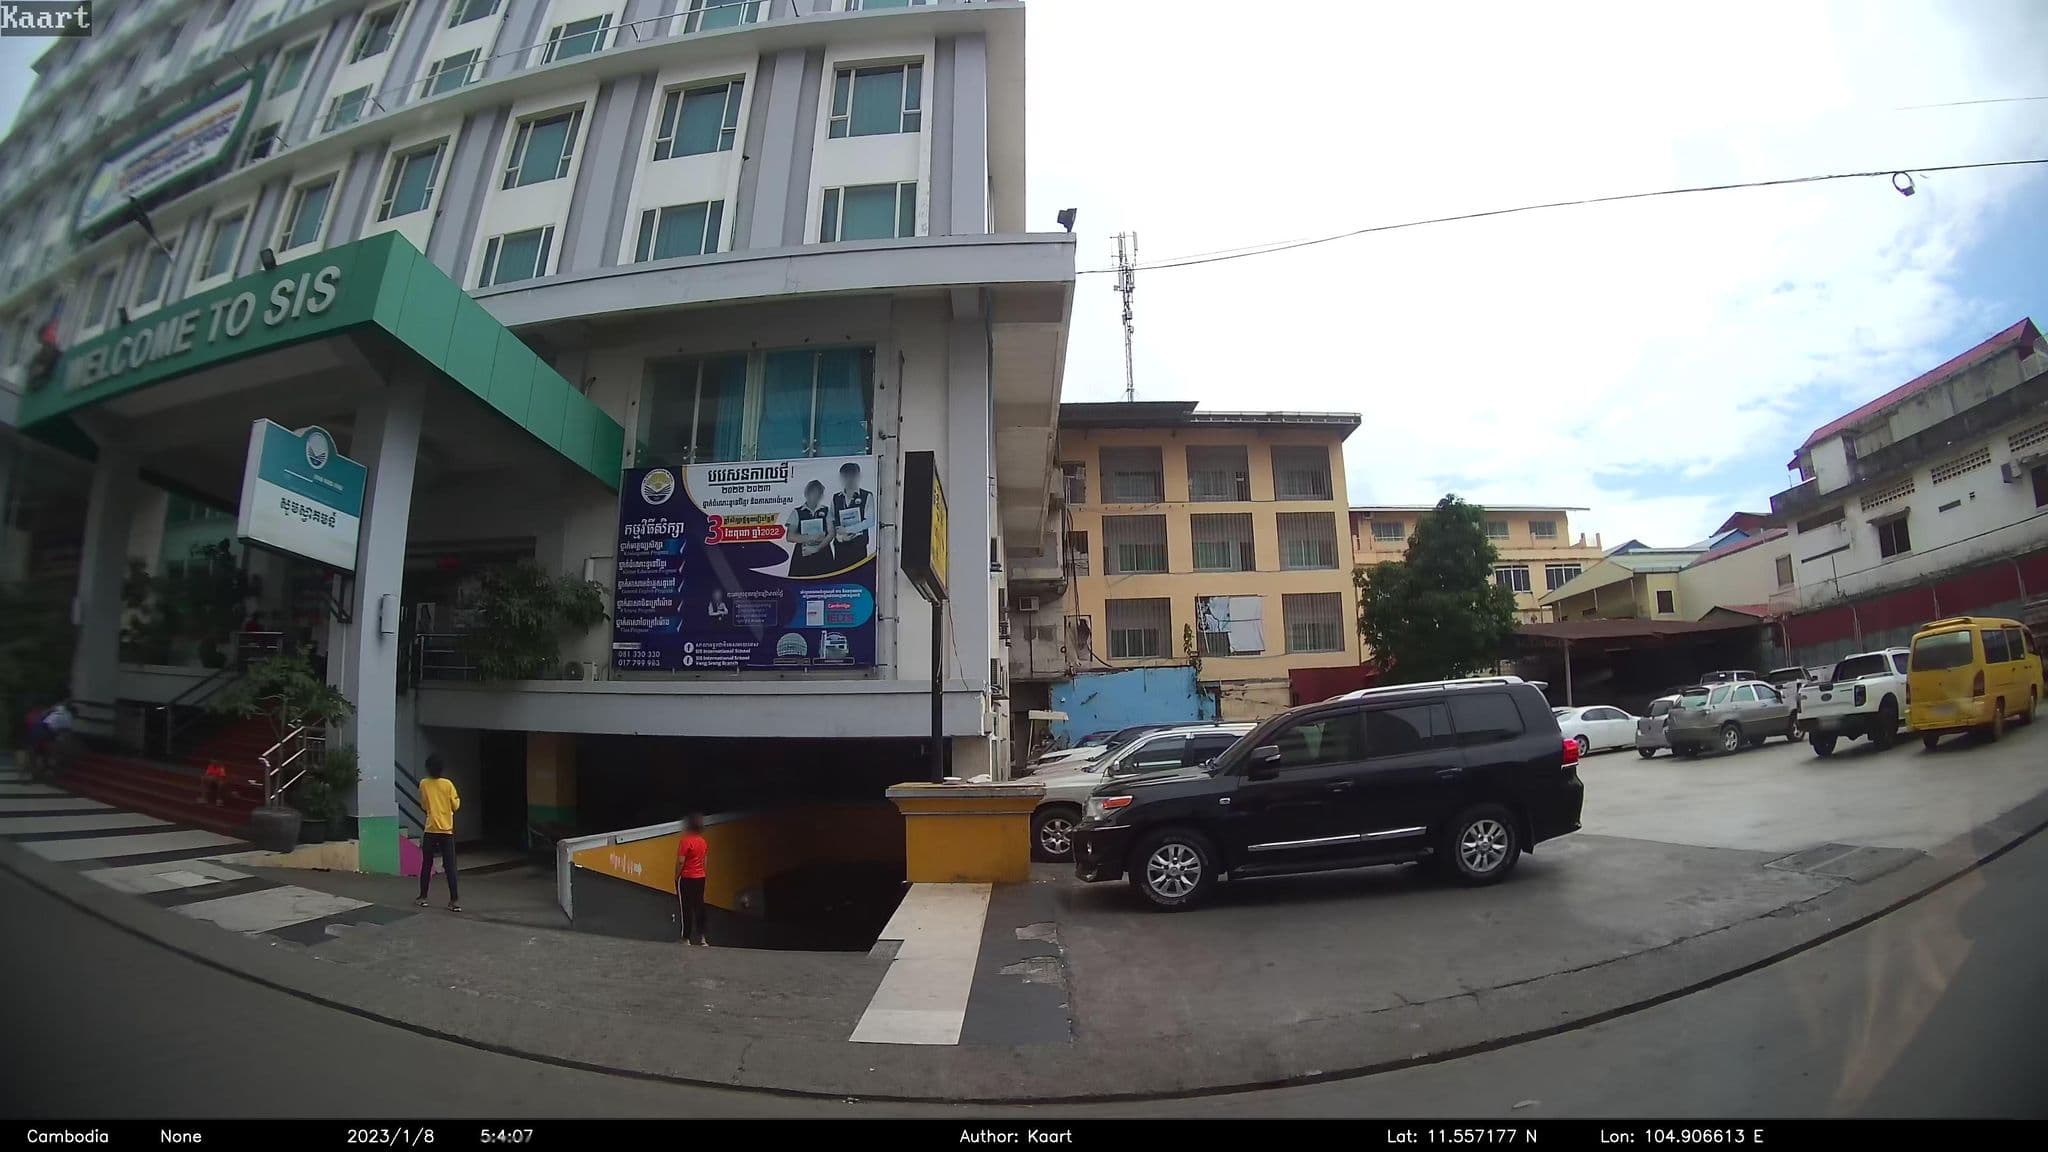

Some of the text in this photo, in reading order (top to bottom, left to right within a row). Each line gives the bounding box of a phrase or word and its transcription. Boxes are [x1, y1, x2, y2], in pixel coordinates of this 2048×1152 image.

[64, 265, 341, 392] WELCOME TO SIS
[705, 514, 724, 545] 3
